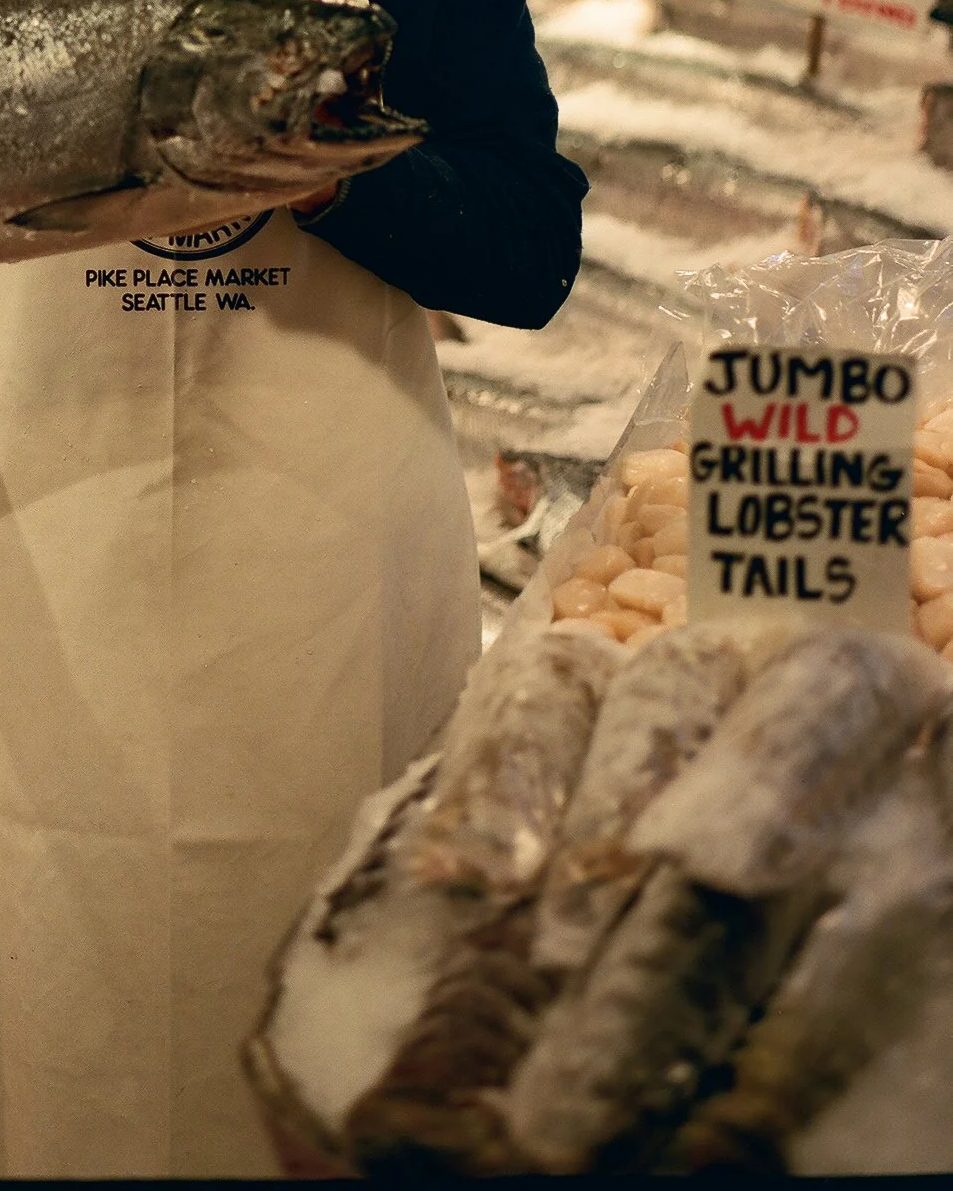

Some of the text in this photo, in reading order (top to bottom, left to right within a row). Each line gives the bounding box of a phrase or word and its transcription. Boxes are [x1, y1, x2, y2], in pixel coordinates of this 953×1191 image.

[85, 267, 291, 287] PIKE PLACE MARKET
[121, 293, 256, 312] SEATTLE WA.
[703, 347, 912, 405] JUMBO
[720, 401, 861, 445] WILD
[690, 441, 904, 493] GRILLING
[707, 491, 910, 548] LOBSTER
[710, 550, 857, 605] TAILS
